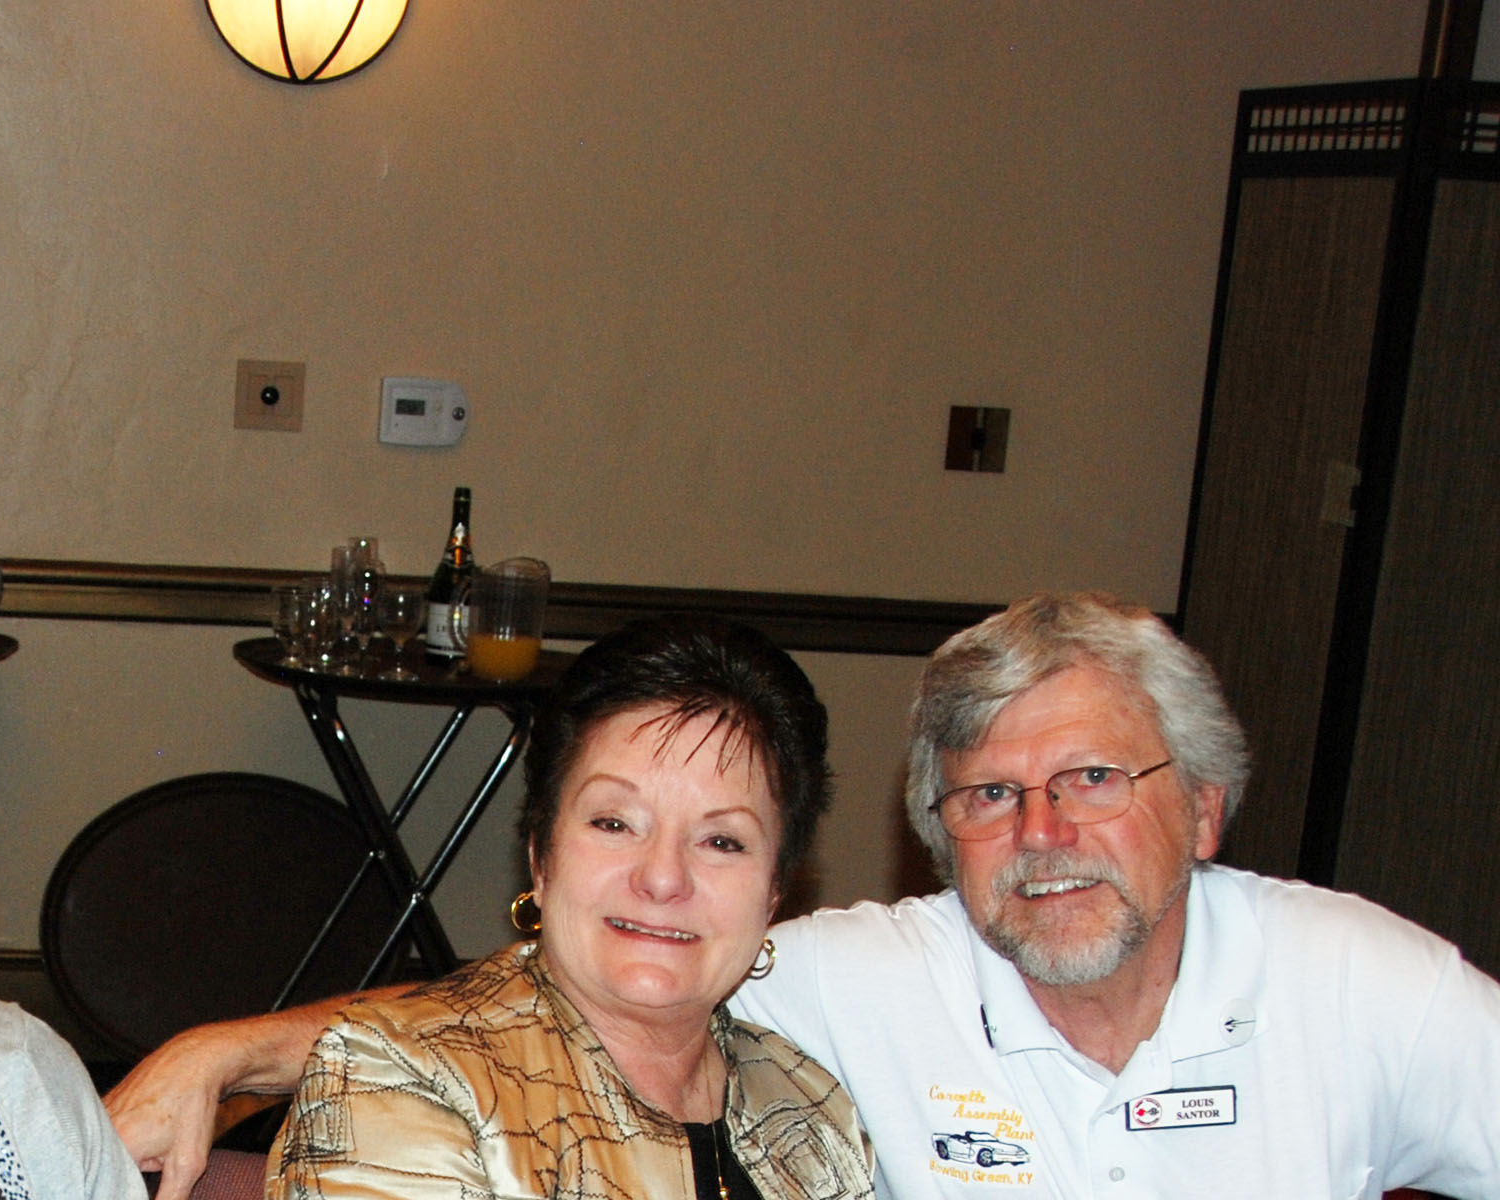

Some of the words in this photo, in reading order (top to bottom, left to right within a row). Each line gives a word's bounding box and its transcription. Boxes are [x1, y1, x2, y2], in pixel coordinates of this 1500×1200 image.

[1182, 1098, 1214, 1108] LOUIS
[953, 1103, 1023, 1126] Assembly
[1177, 1109, 1219, 1120] SANTOR
[994, 1122, 1034, 1140] Plant
[972, 1169, 1013, 1184] Green,
[1017, 1172, 1033, 1184] KY
